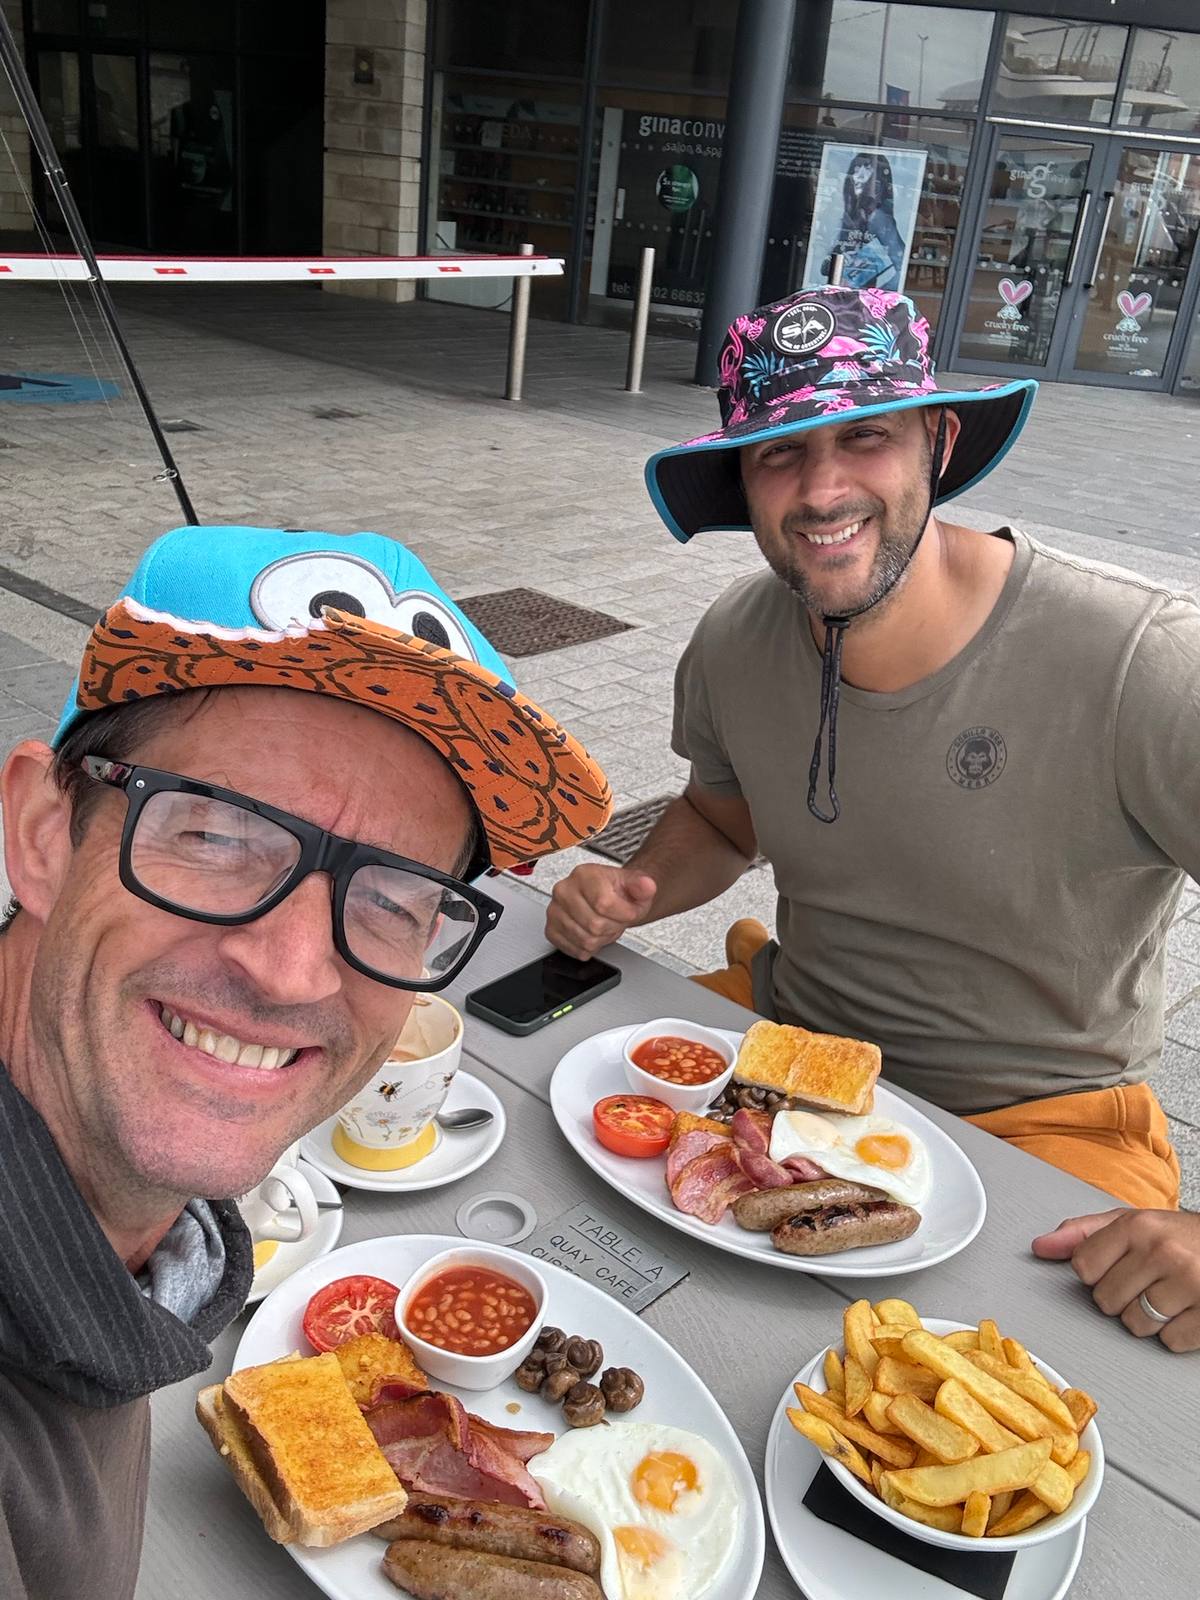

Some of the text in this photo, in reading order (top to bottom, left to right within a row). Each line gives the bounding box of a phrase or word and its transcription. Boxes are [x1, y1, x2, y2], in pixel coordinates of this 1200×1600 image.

[665, 142, 694, 154] salon
[1012, 320, 1030, 333] free
[1131, 332, 1150, 345] free
[577, 1214, 664, 1280] TABLE A
[549, 1234, 639, 1298] QUAY CAFE
